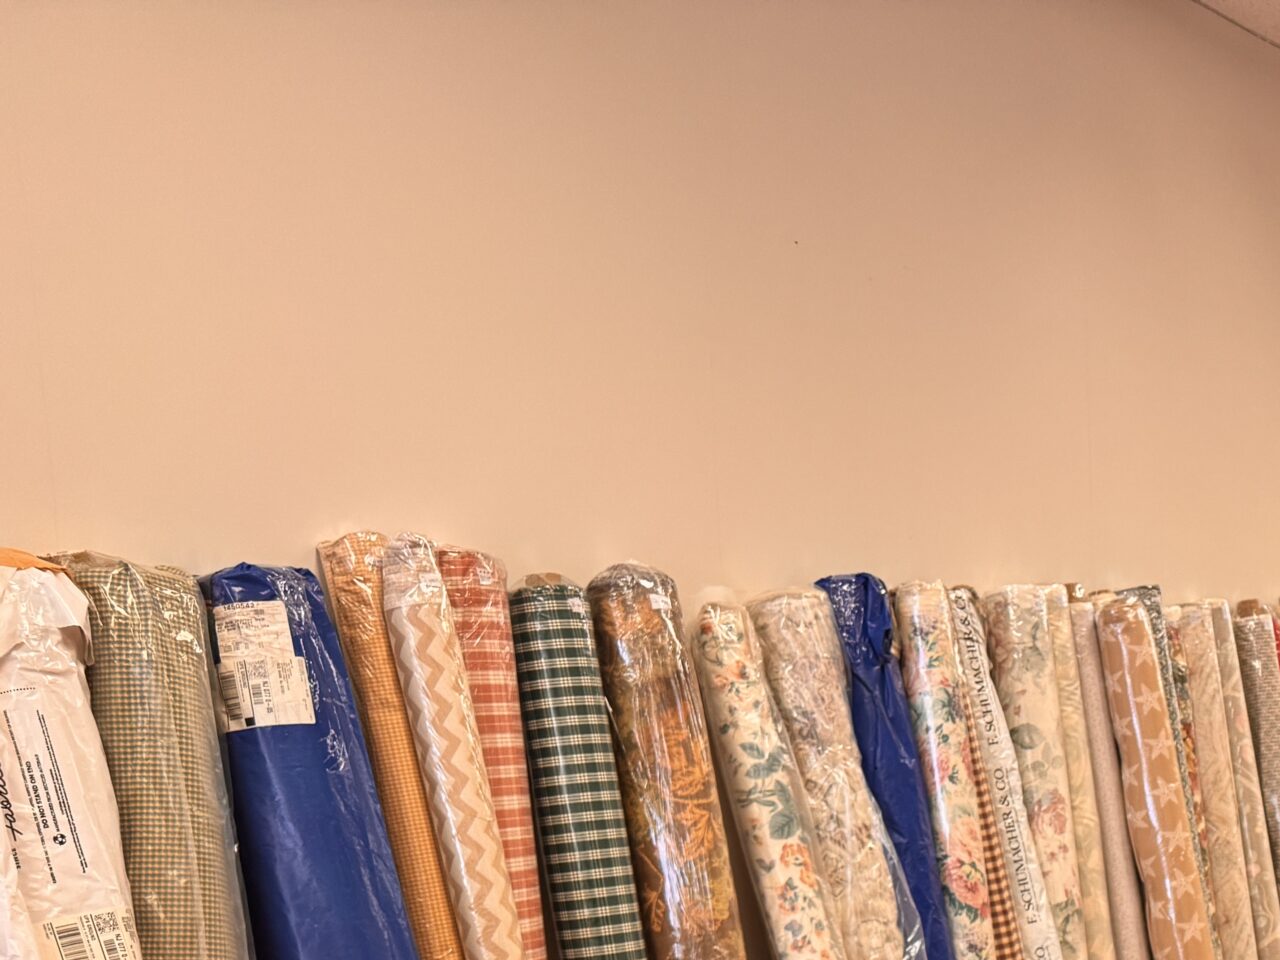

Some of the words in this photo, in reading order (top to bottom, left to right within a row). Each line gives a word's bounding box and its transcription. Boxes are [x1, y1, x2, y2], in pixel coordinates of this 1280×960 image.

[960, 616, 971, 628] &
[29, 774, 36, 784] ON
[32, 785, 43, 806] STAND
[1000, 795, 1010, 806] &
[38, 806, 46, 820] NOT
[42, 820, 49, 828] DO
[1002, 810, 1035, 912] SCHUMACHER
[118, 942, 126, 952] 077
